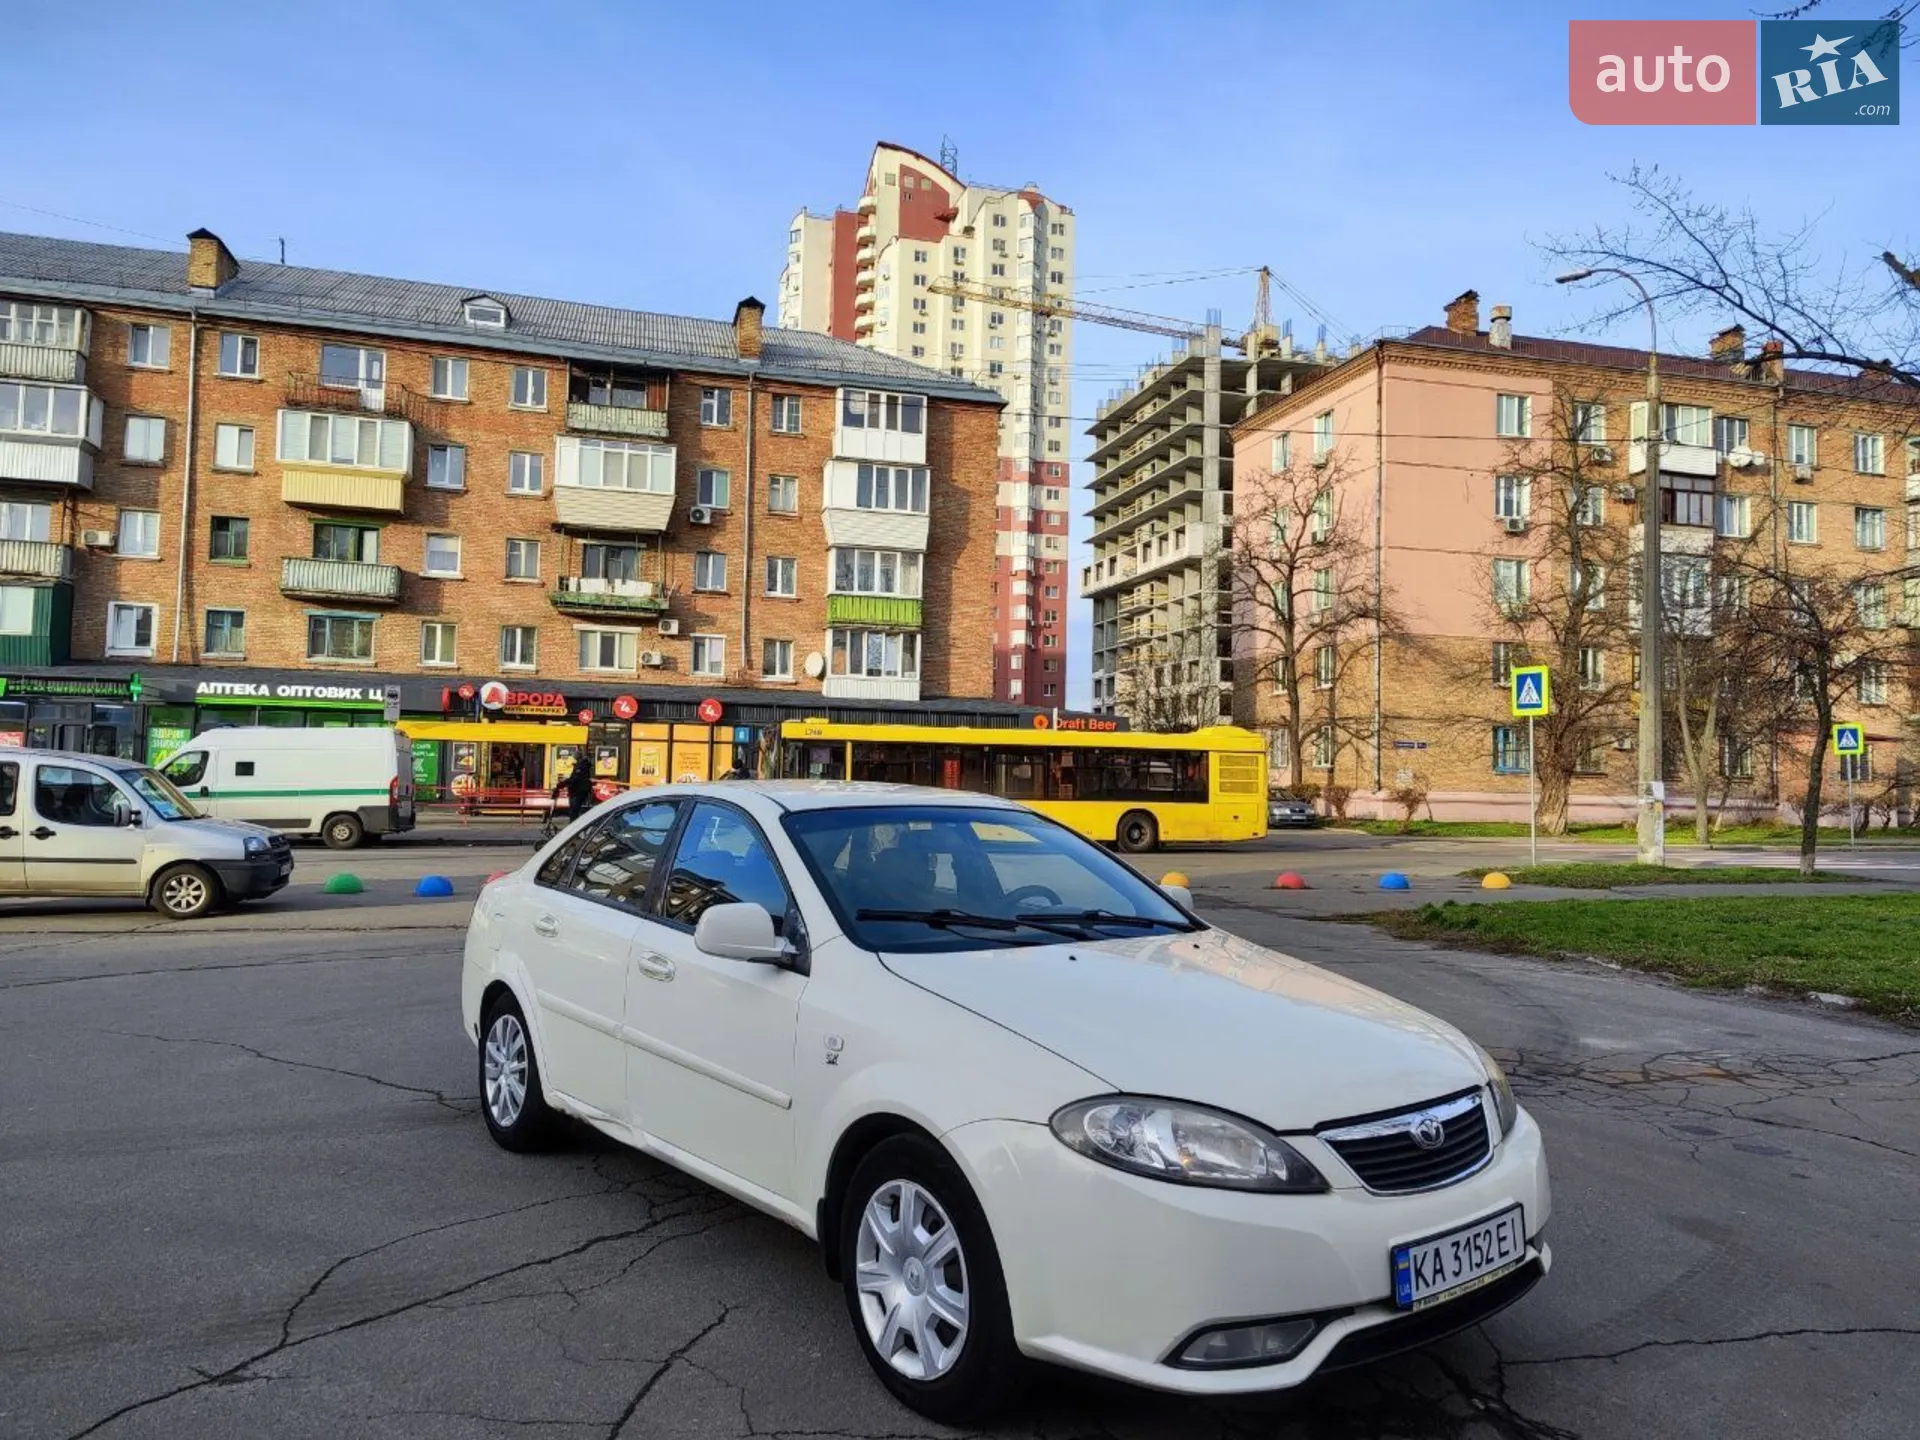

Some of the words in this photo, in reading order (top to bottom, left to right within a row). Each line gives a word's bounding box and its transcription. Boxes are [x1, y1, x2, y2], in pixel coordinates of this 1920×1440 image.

[196, 682, 270, 697] АПТЕКА
[277, 685, 362, 700] ОПТОВИХ
[484, 687, 566, 707] АВРОРА
[1056, 718, 1085, 730] Draft
[1089, 718, 1117, 731] Beer
[1413, 1247, 1447, 1292] KA
[1450, 1228, 1495, 1278] 3152
[1496, 1217, 1518, 1259] EI
